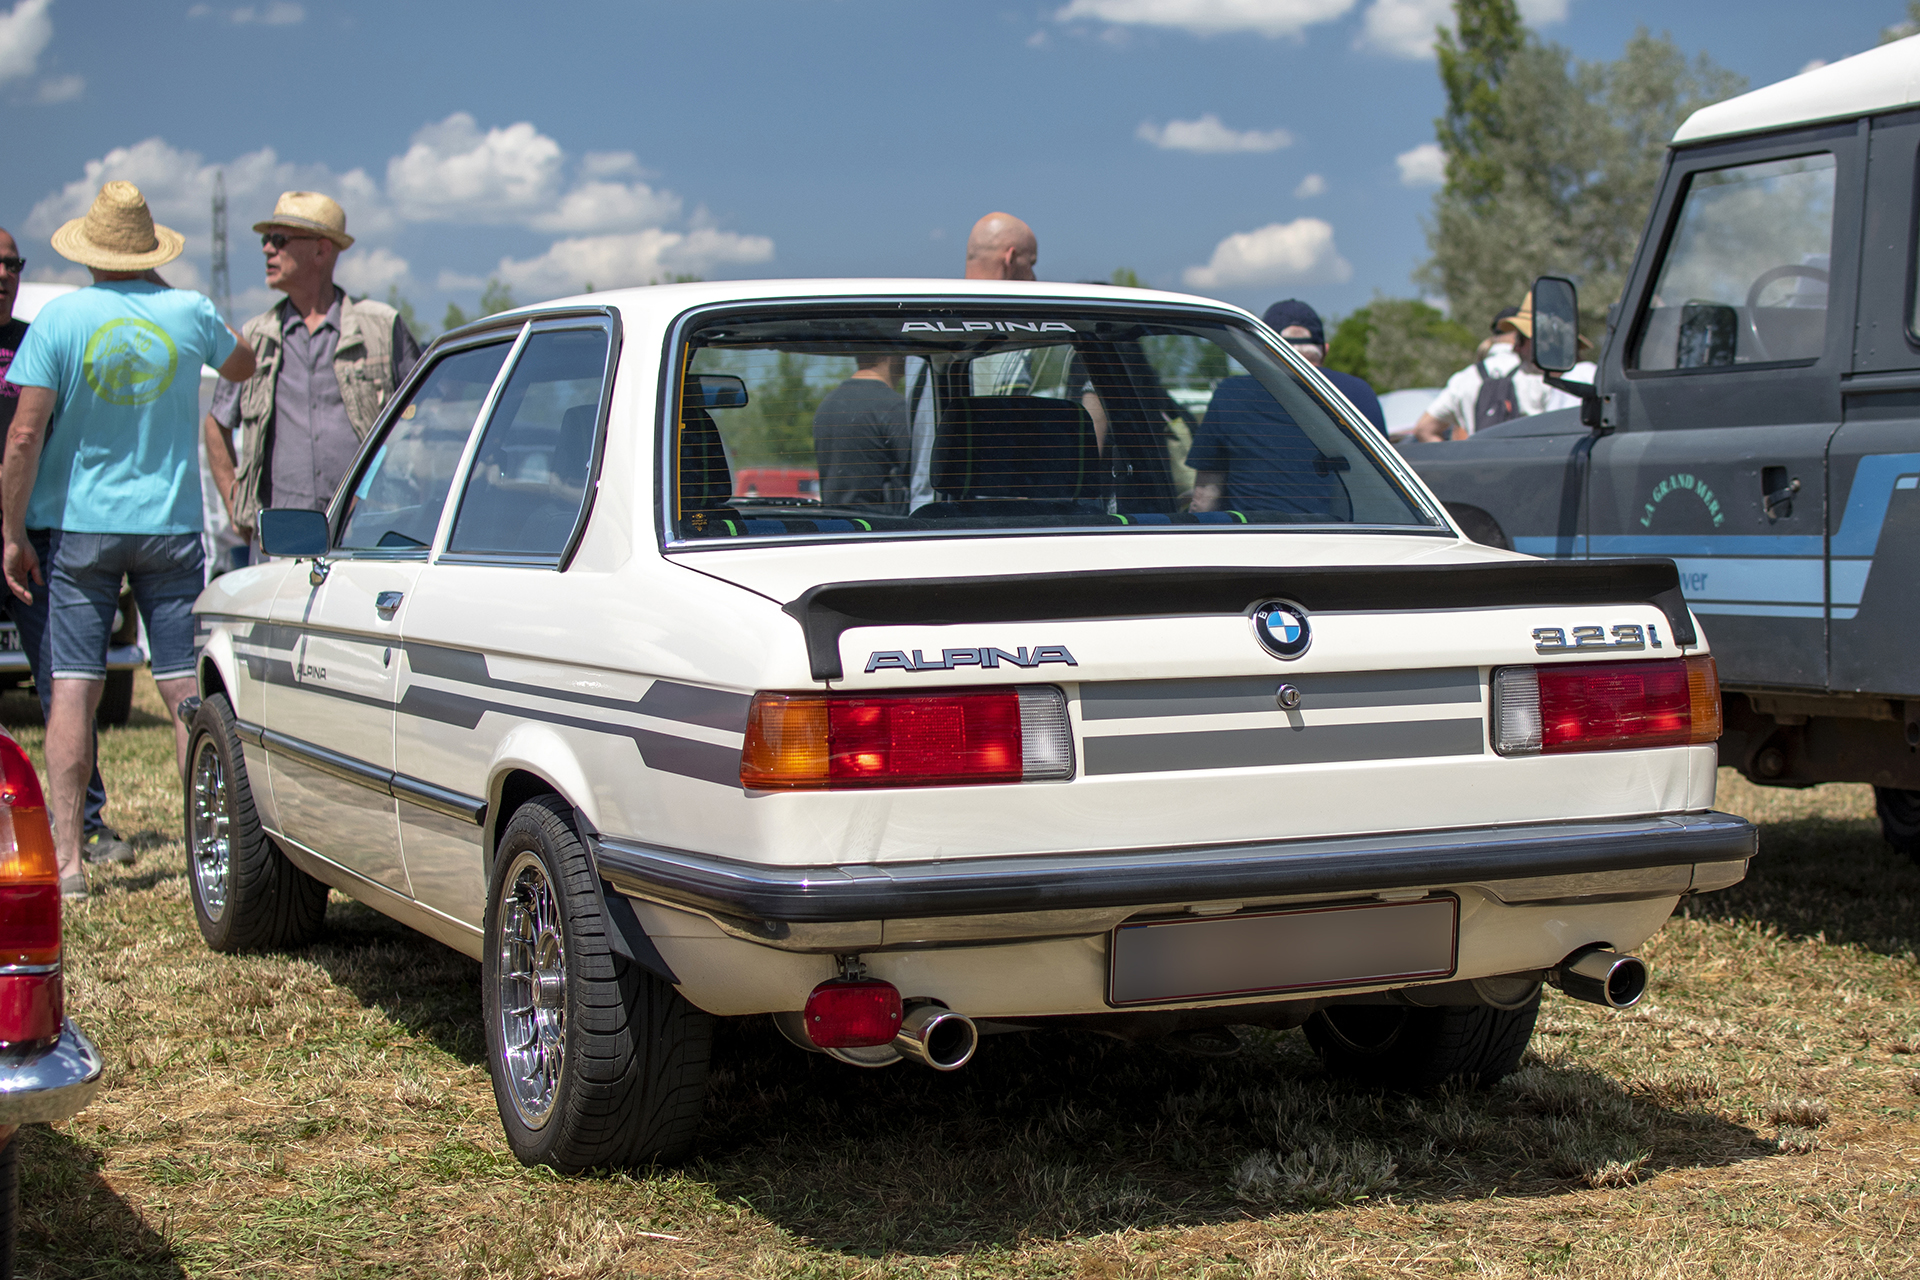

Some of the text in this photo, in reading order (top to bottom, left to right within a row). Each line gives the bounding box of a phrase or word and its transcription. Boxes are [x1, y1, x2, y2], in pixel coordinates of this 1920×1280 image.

[901, 321, 1076, 333] ALPINA
[1640, 503, 1656, 528] LA
[1652, 473, 1695, 503] GRAND
[1679, 572, 1708, 591] ver
[1258, 604, 1303, 620] BMW
[864, 645, 1078, 673] ALPINA
[296, 663, 327, 680] ALPINA
